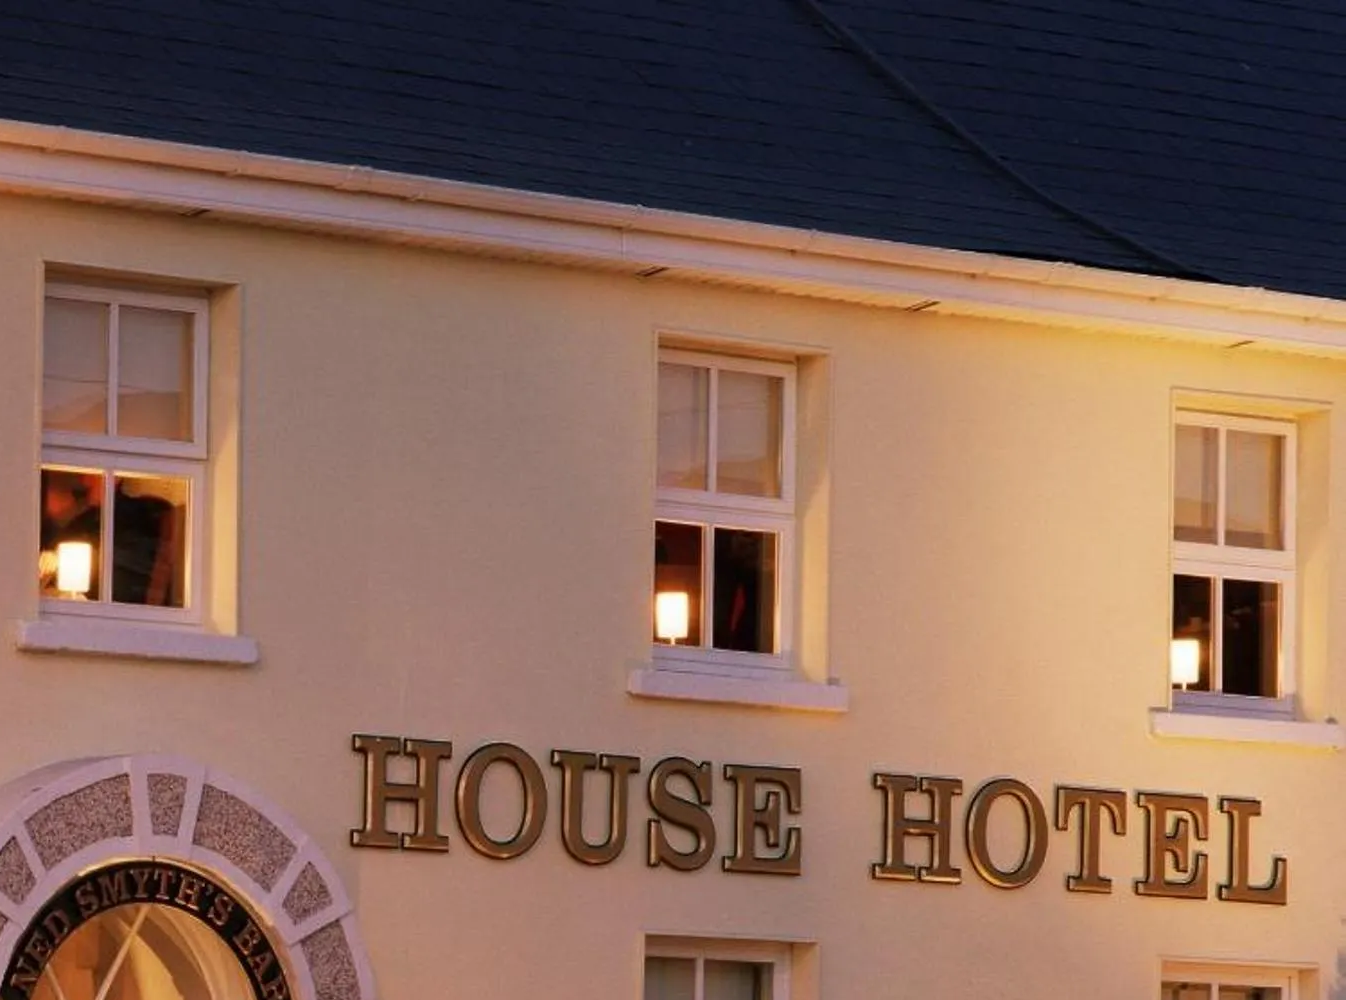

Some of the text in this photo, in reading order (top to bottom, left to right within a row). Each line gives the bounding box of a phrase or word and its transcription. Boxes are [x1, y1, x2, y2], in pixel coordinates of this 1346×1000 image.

[350, 734, 802, 875] HOUSE
[871, 771, 1288, 905] HOTEL
[10, 909, 70, 996] NED
[75, 866, 235, 927] SMYTH'S
